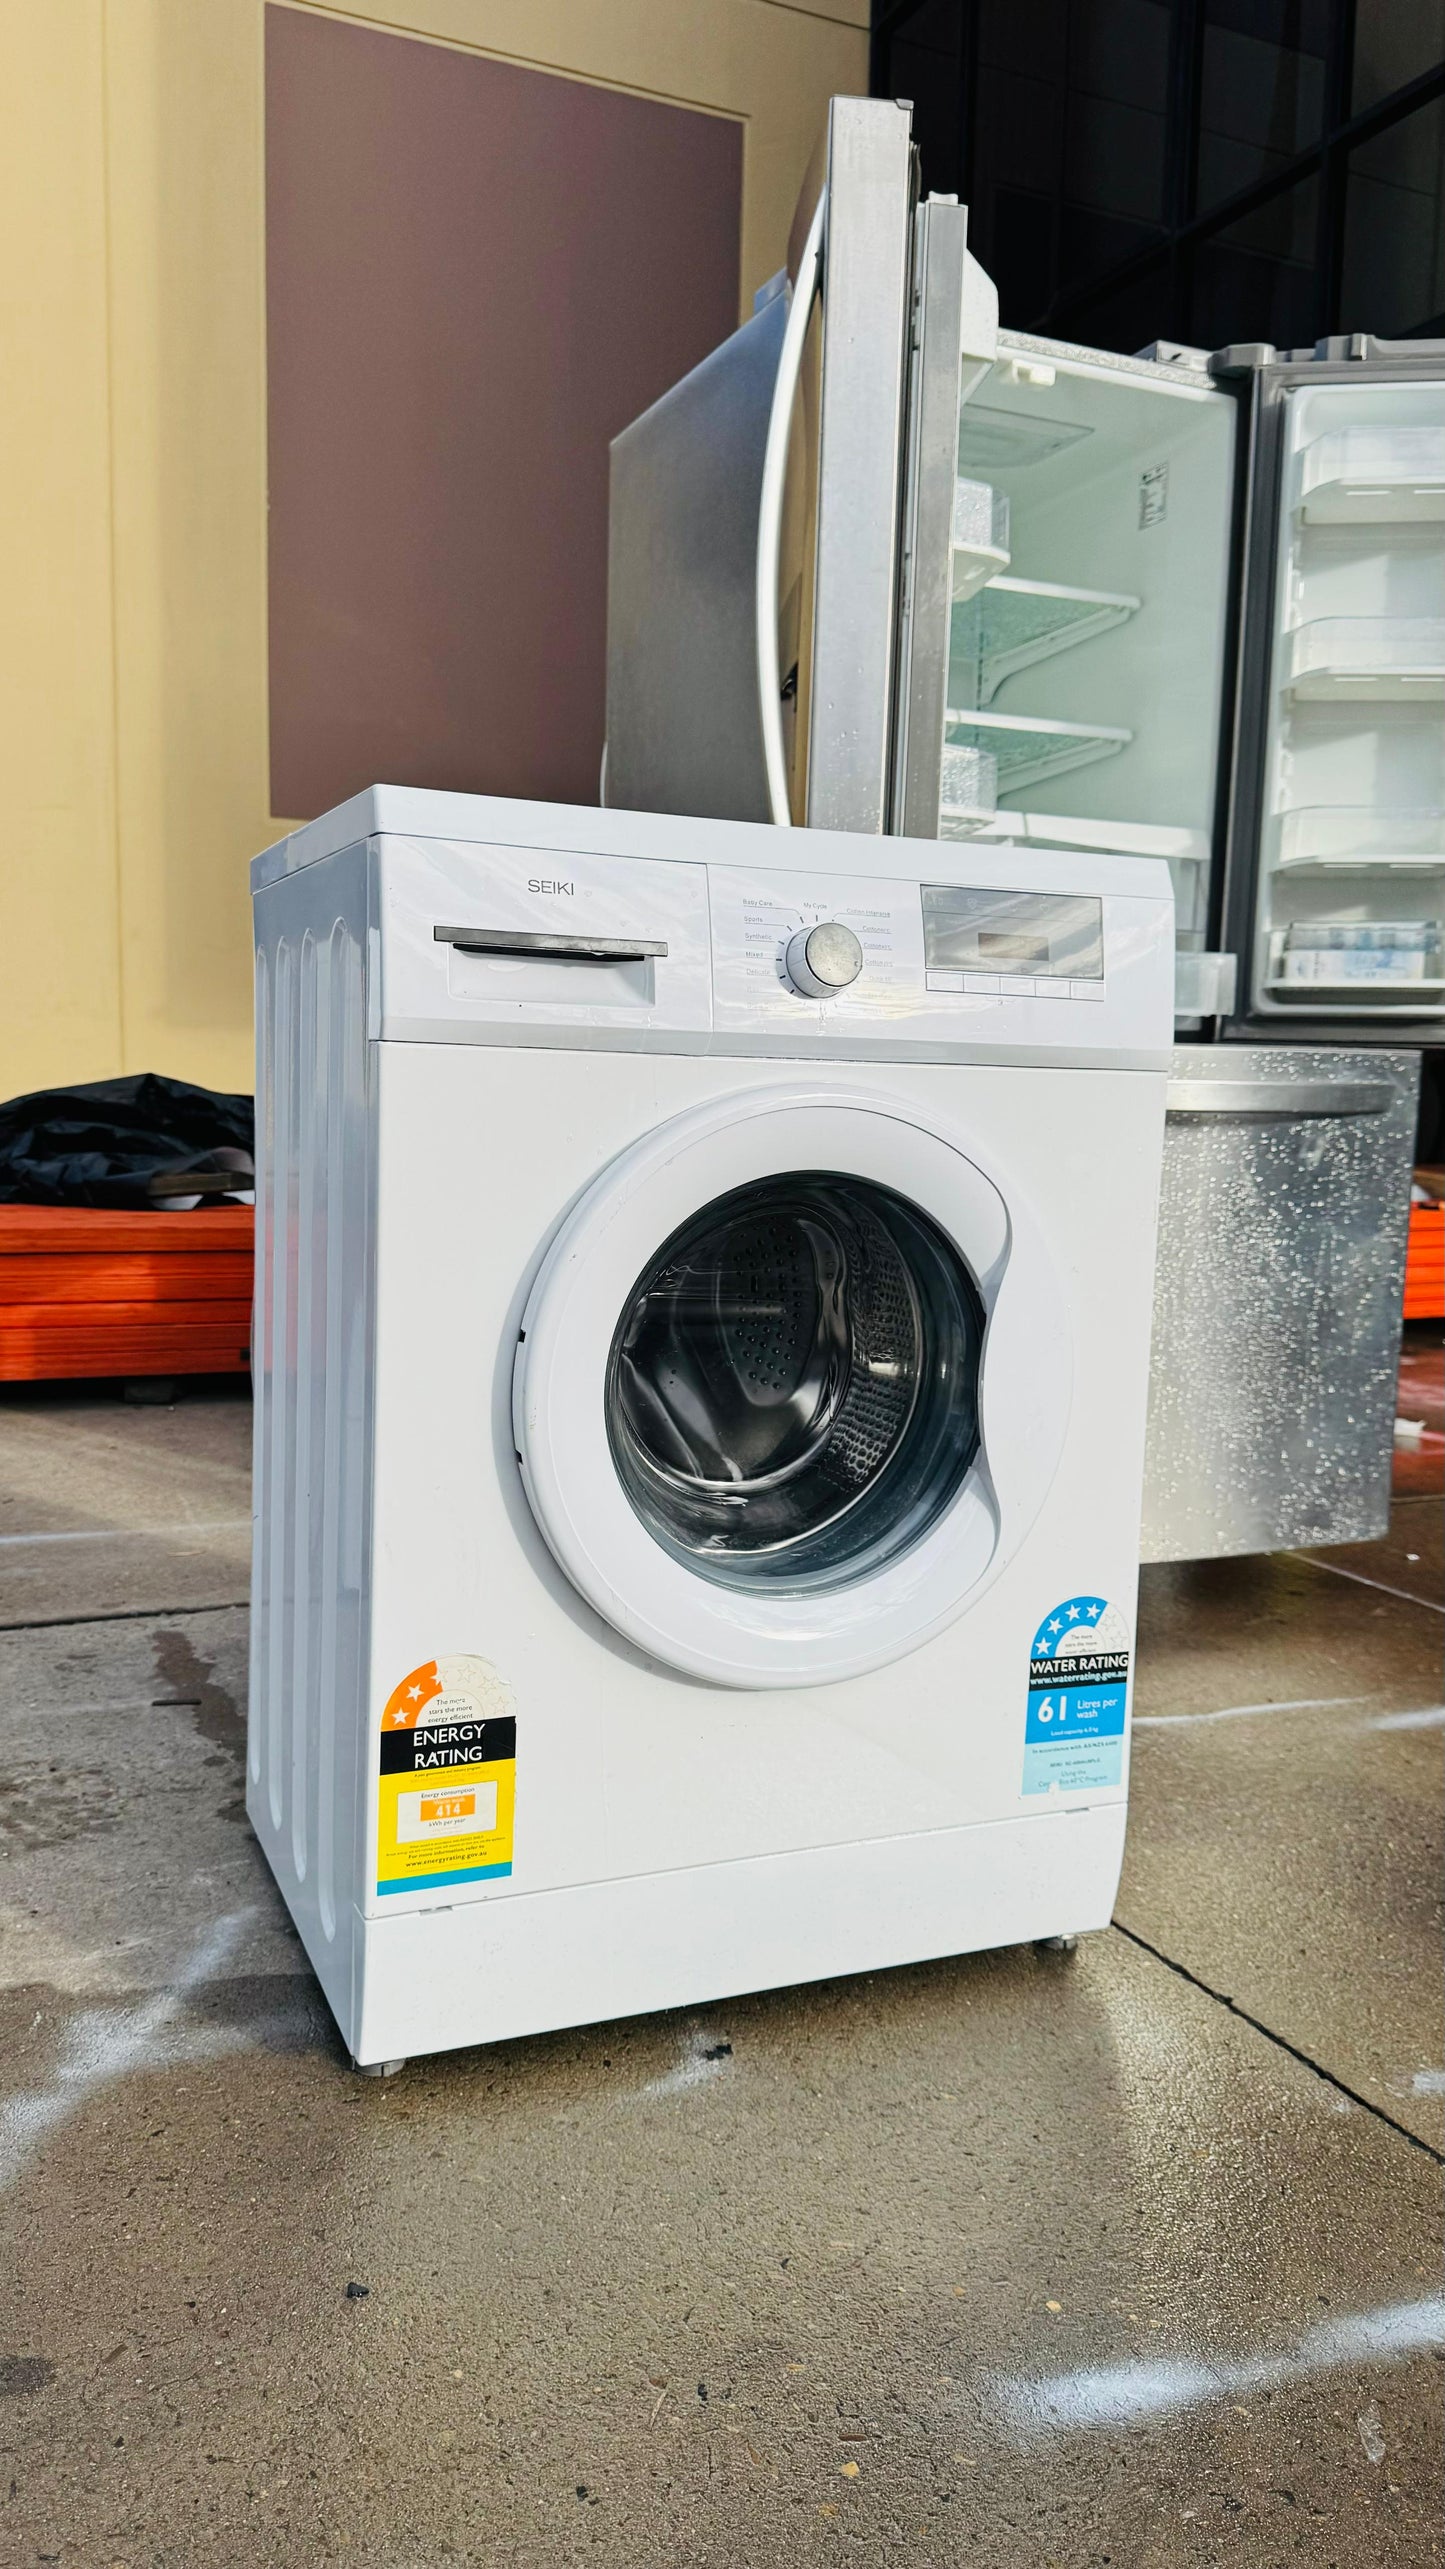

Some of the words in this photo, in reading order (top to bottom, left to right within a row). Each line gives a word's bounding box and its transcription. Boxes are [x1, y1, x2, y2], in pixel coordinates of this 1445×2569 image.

[528, 879, 574, 896] SEIKI
[742, 898, 758, 907] Baby
[803, 902, 812, 910] My
[812, 902, 828, 910] Cycle
[745, 932, 772, 940] Synthetic
[746, 968, 771, 976] Delicate
[1030, 1658, 1077, 1674] WATER
[1079, 1654, 1129, 1670] RATING
[1030, 1670, 1127, 1685] www.waterrating.gov.au
[1038, 1696, 1067, 1723] 61
[1077, 1700, 1100, 1710] Litres
[1102, 1698, 1118, 1709] per
[428, 1708, 444, 1716] stars
[444, 1706, 455, 1714] the
[1076, 1709, 1098, 1718] wash
[427, 1716, 448, 1724] energy
[450, 1713, 474, 1721] efficient
[413, 1723, 486, 1747] ENERGY
[414, 1746, 483, 1769] RATING
[421, 1792, 440, 1800] Energy
[440, 1786, 476, 1796] consumption
[436, 1803, 461, 1818] 414
[444, 1819, 453, 1827] per
[454, 1818, 466, 1826] year
[405, 1850, 488, 1868] www.energyrating.gov.au
